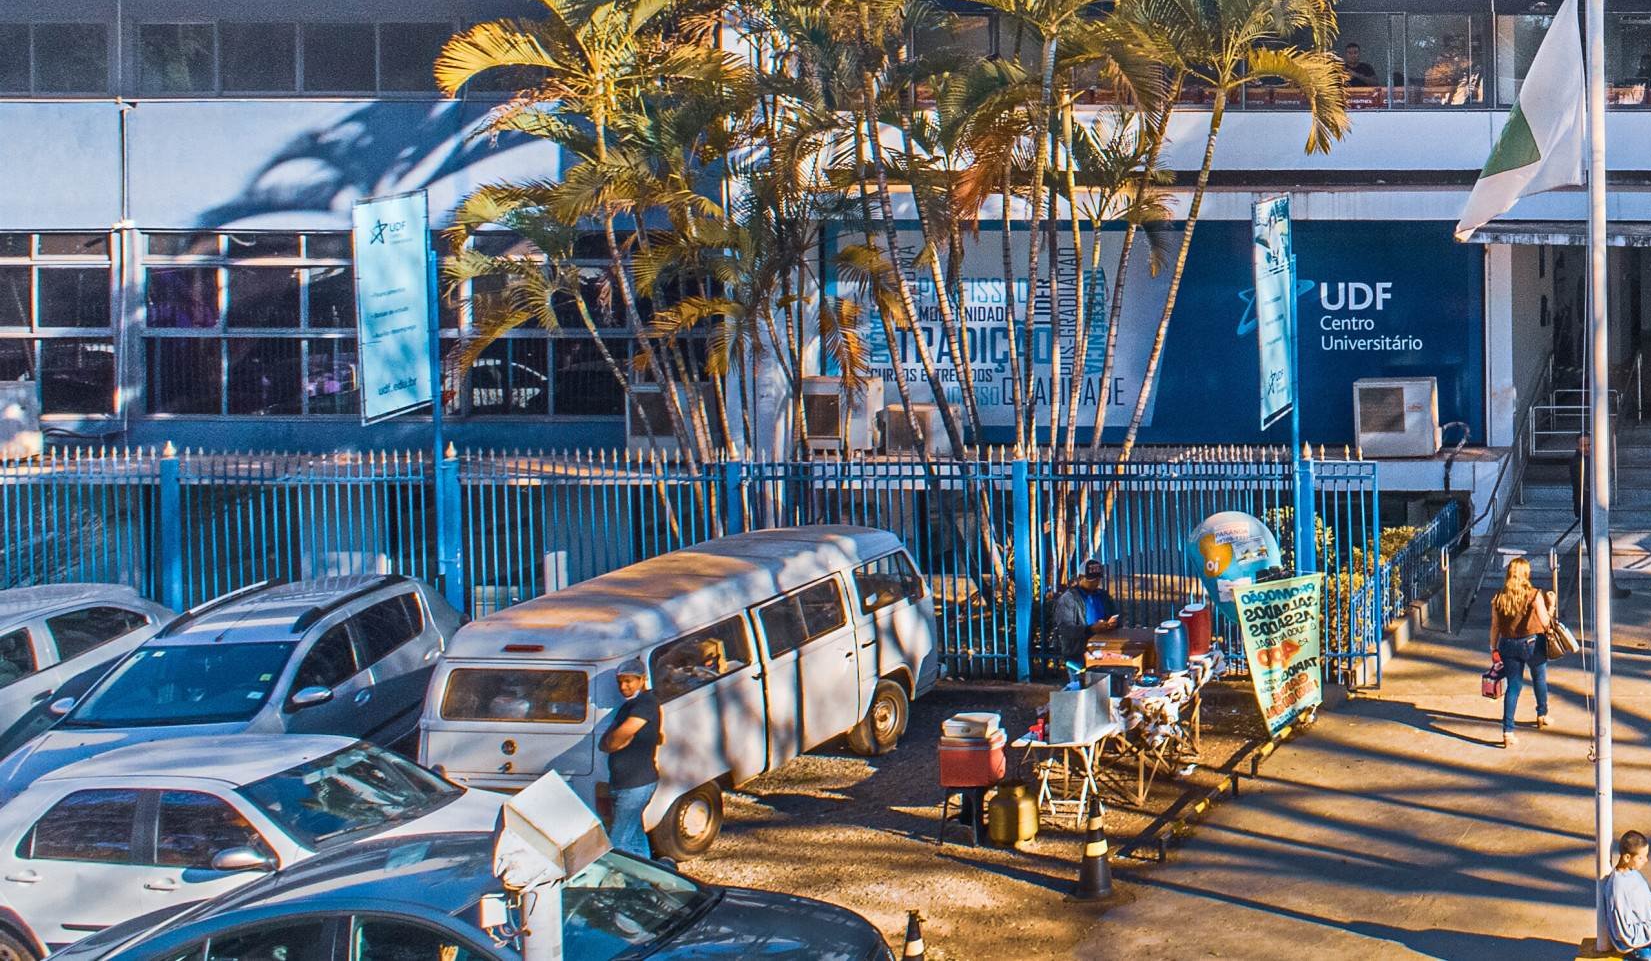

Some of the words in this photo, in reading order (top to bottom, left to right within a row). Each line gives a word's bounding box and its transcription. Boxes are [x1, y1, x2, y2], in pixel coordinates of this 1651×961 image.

[1319, 281, 1393, 311] UDF
[1319, 315, 1375, 331] Centro
[1321, 335, 1424, 351] Universitário
